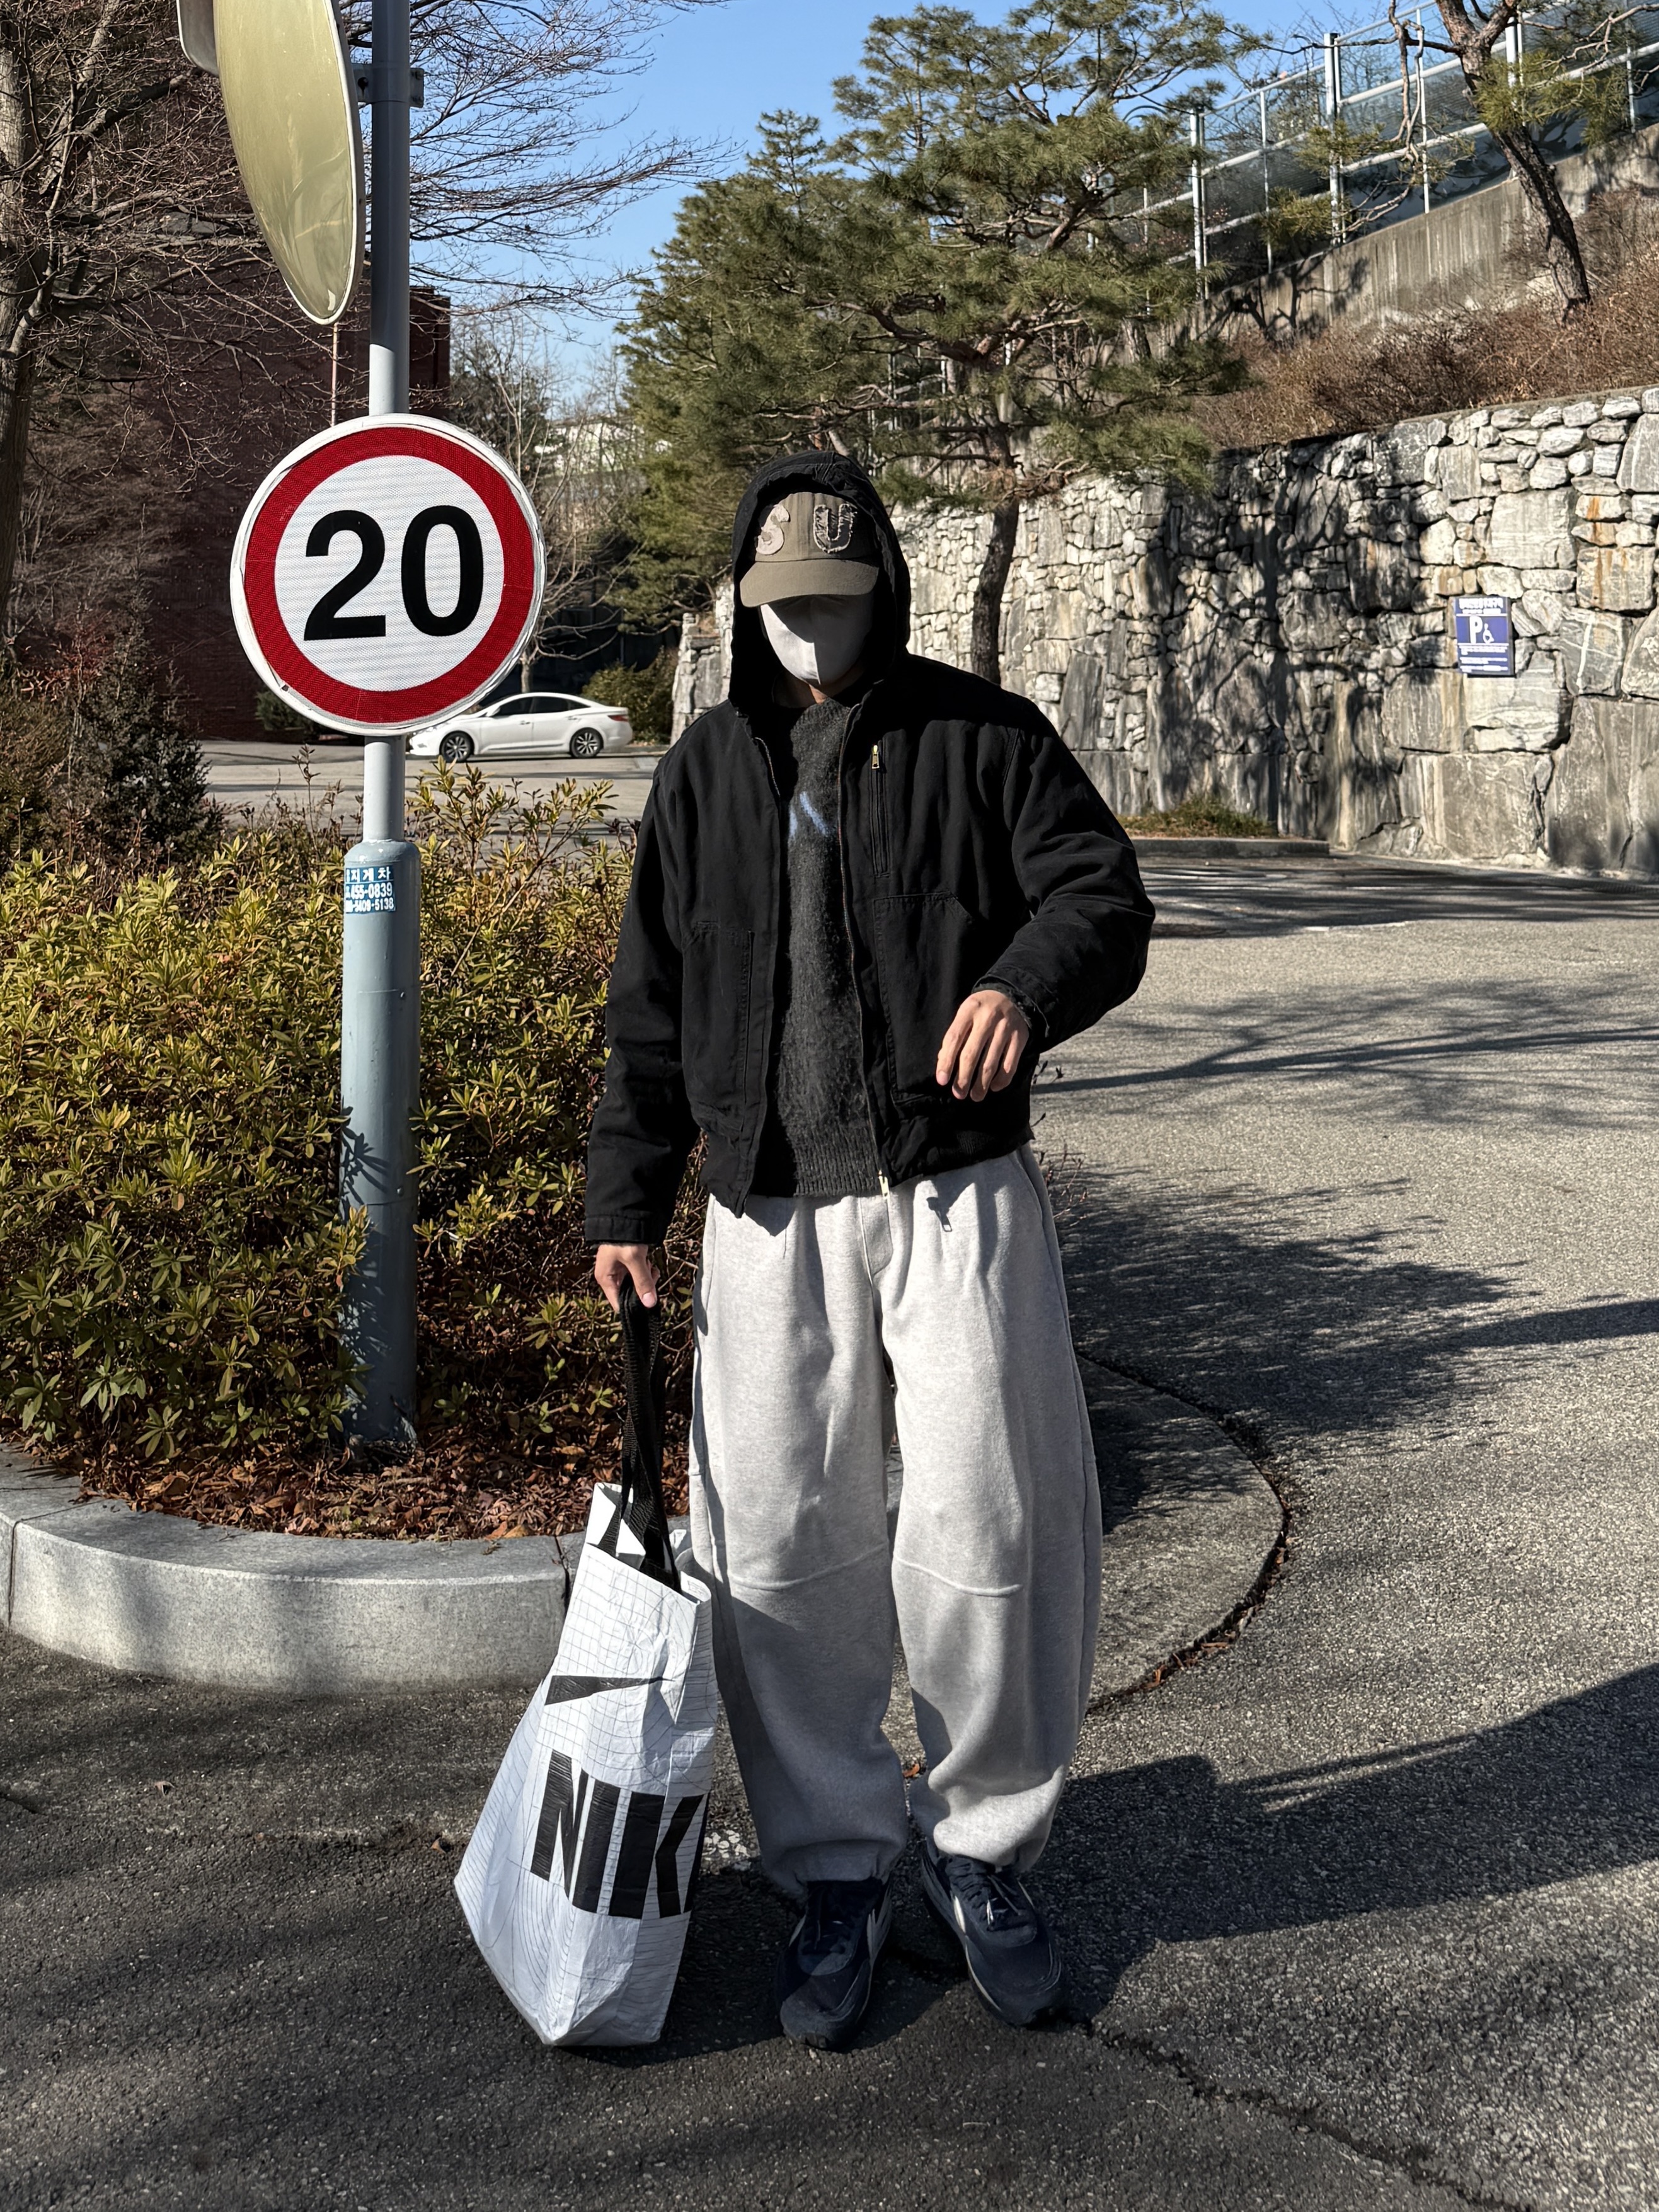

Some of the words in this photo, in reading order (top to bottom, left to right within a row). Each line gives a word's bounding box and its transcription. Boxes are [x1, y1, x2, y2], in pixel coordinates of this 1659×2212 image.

[304, 505, 484, 641] 20
[1469, 616, 1483, 644] P
[531, 1749, 709, 1920] NIK
